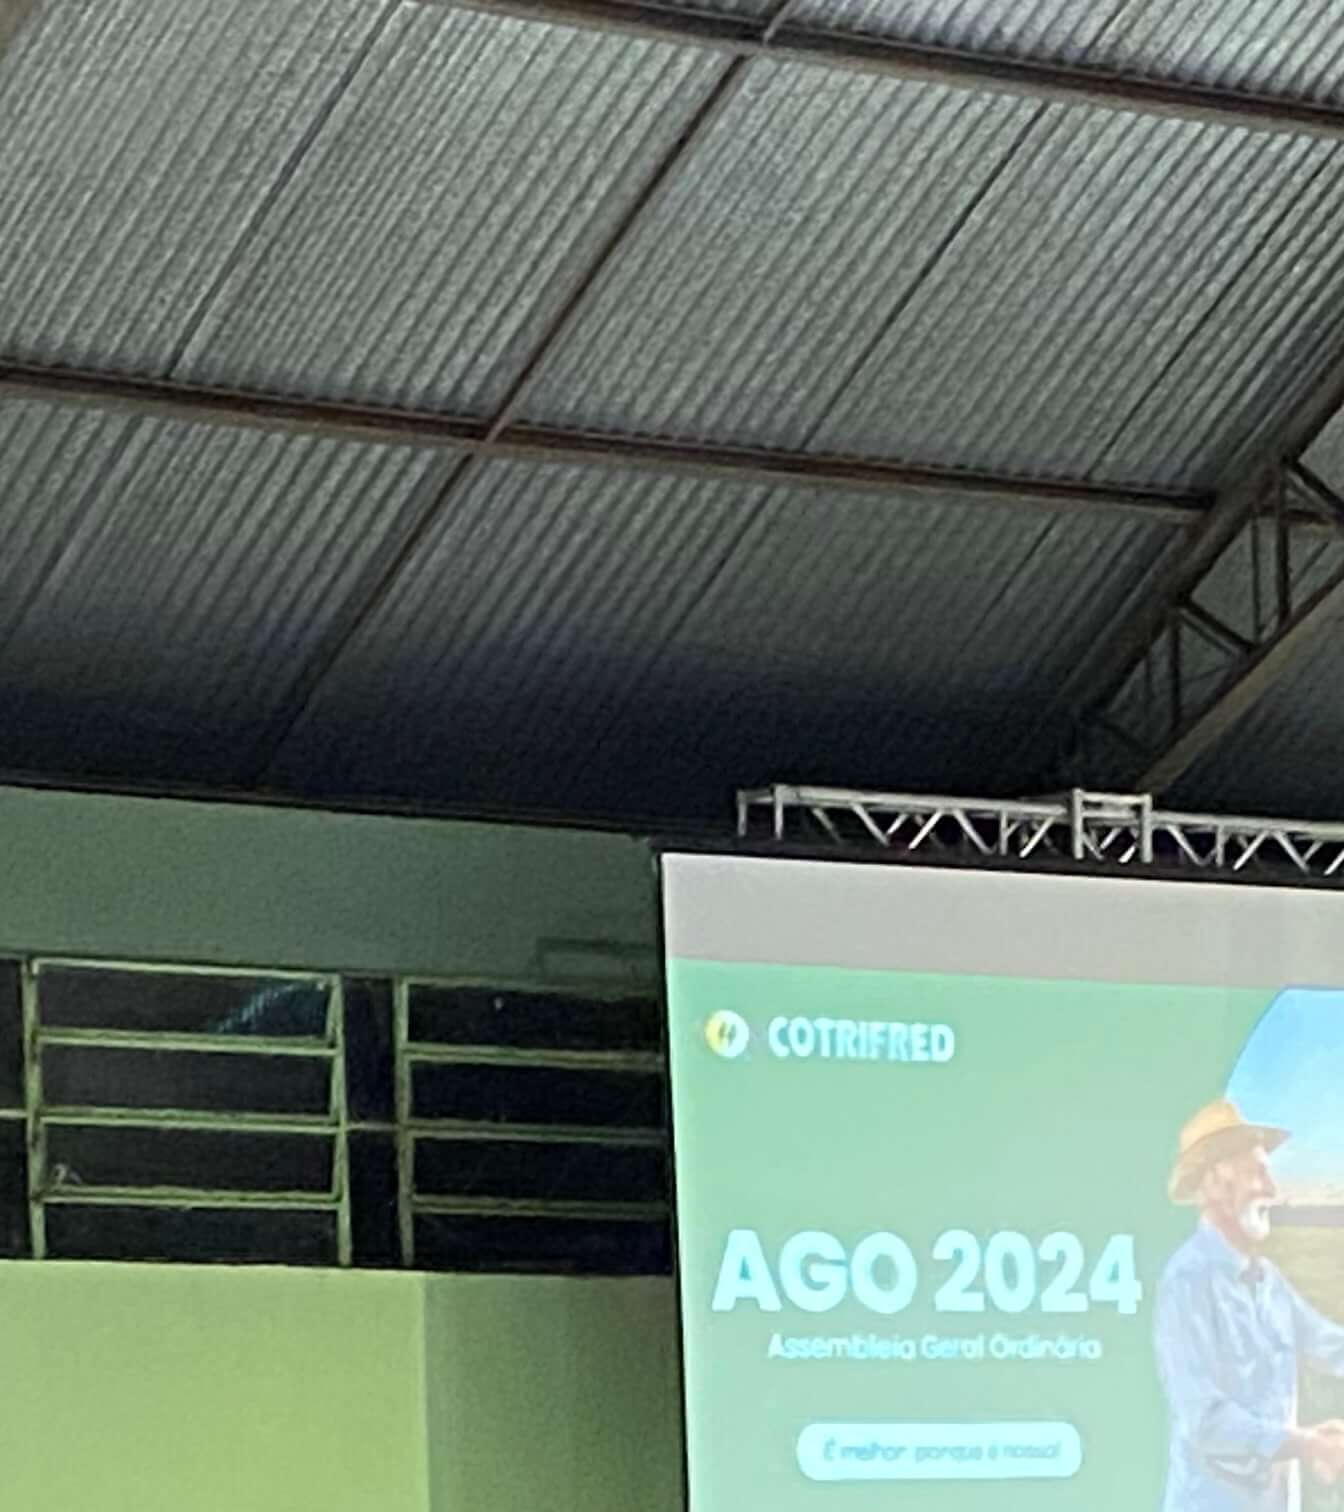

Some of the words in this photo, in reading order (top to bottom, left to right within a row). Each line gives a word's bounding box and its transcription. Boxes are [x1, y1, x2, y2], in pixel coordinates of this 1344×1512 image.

[768, 1016, 955, 1062] COTRIFRED
[711, 1228, 917, 1314] AGO
[932, 1229, 1143, 1315] 2024
[768, 1333, 916, 1361] Assembleia
[920, 1335, 984, 1360] Geral
